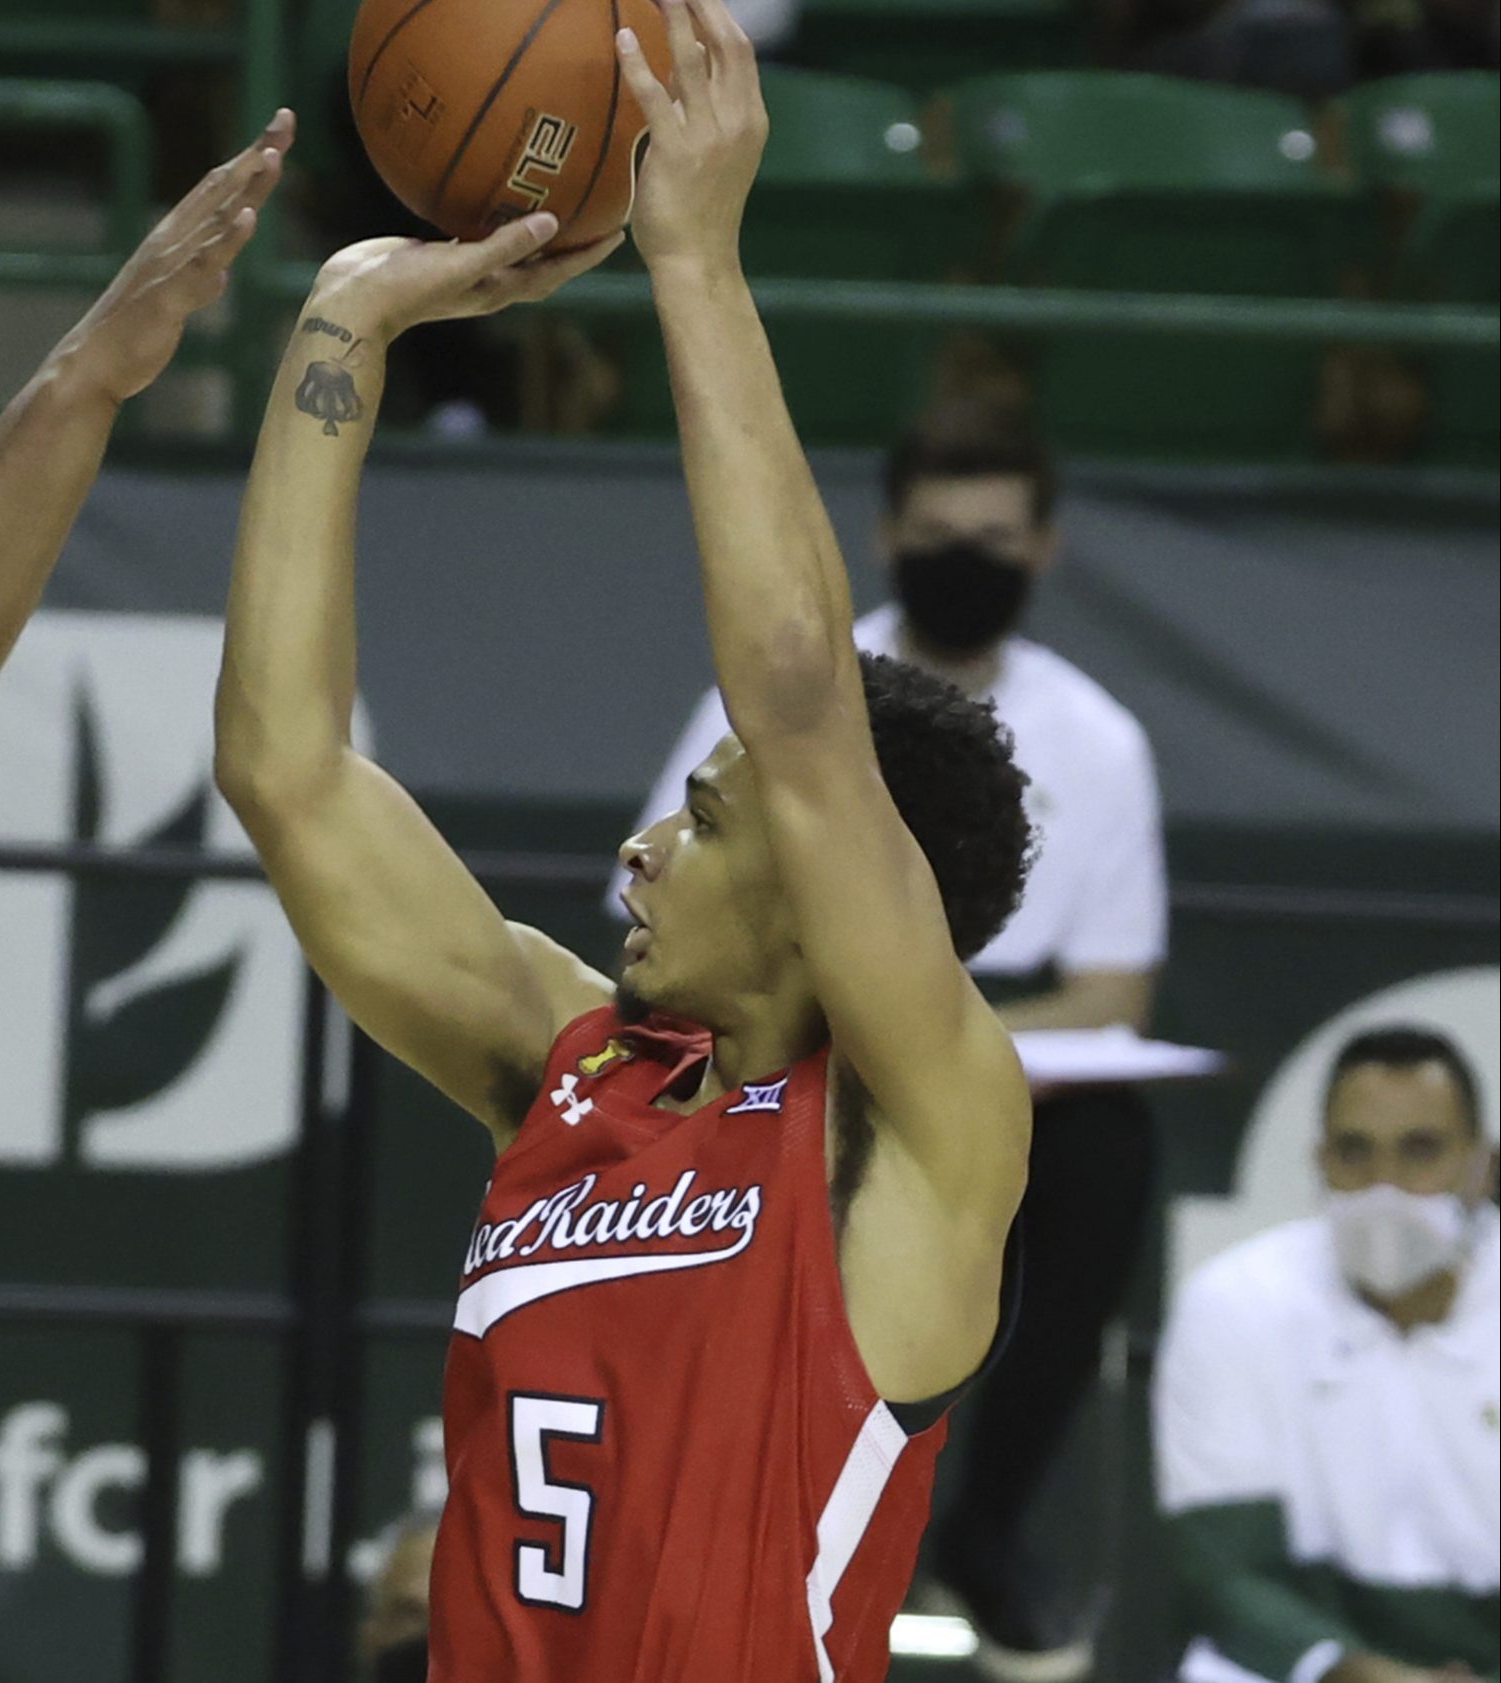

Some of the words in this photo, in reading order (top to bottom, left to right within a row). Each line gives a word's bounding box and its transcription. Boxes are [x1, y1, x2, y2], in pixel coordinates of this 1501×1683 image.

[462, 1198, 547, 1277] ed
[518, 1168, 763, 1258] Raiders
[507, 1389, 607, 1617] 5
